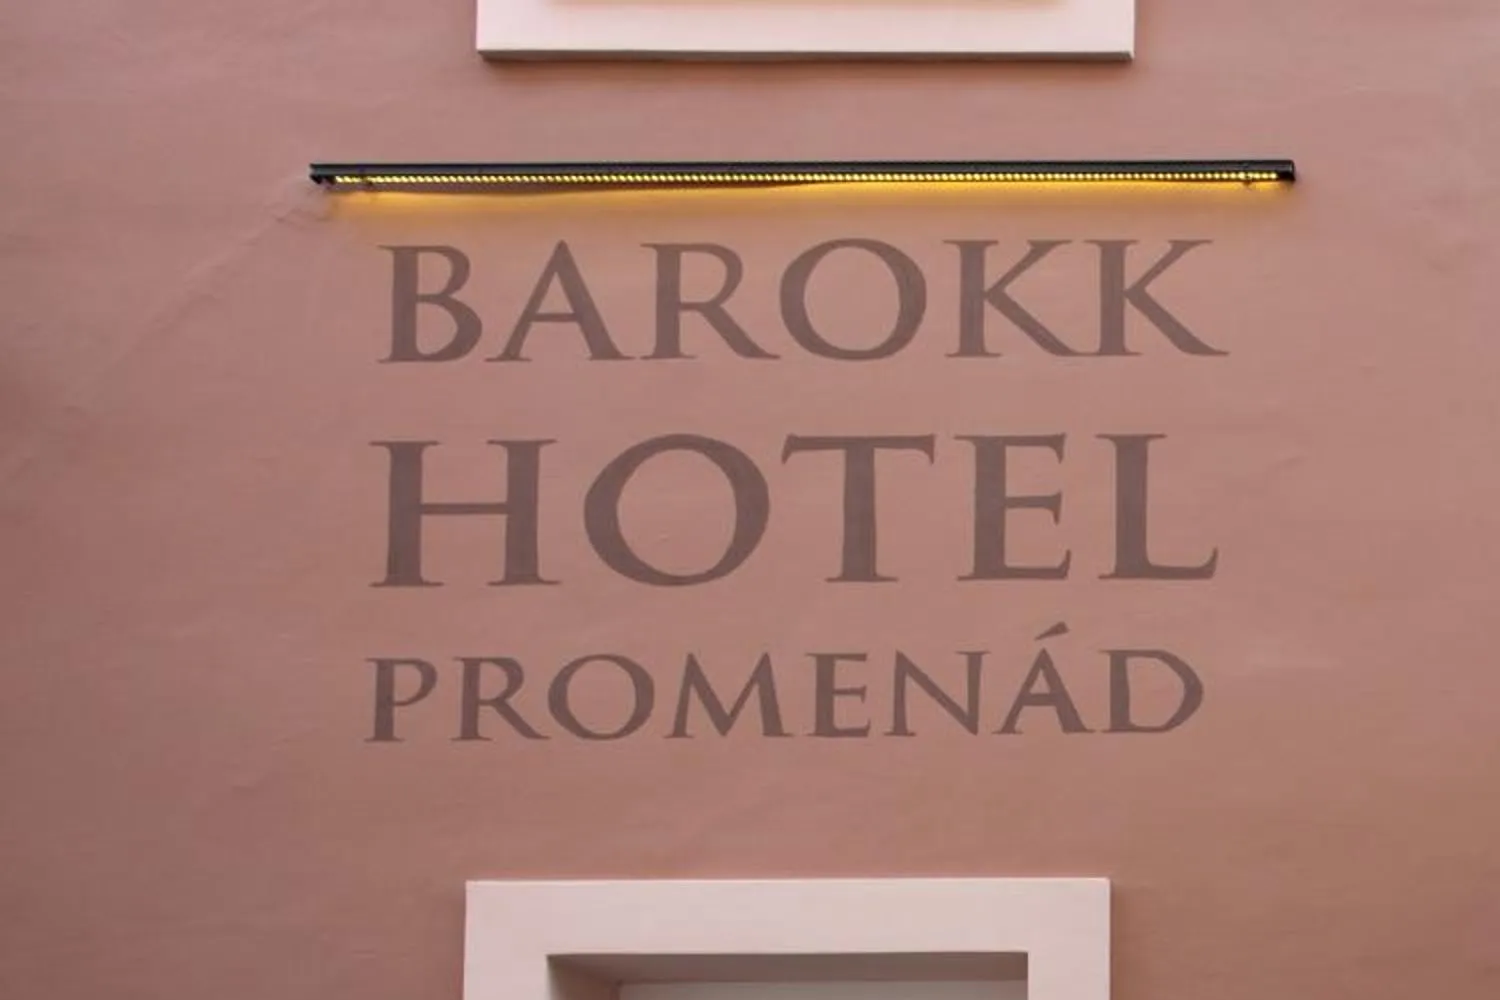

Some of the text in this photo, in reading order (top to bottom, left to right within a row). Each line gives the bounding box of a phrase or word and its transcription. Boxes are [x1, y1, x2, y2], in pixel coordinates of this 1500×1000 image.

[378, 238, 1230, 363] BAROKK
[369, 433, 1219, 587] HOTEL
[364, 621, 1205, 742] PROMENÁD
